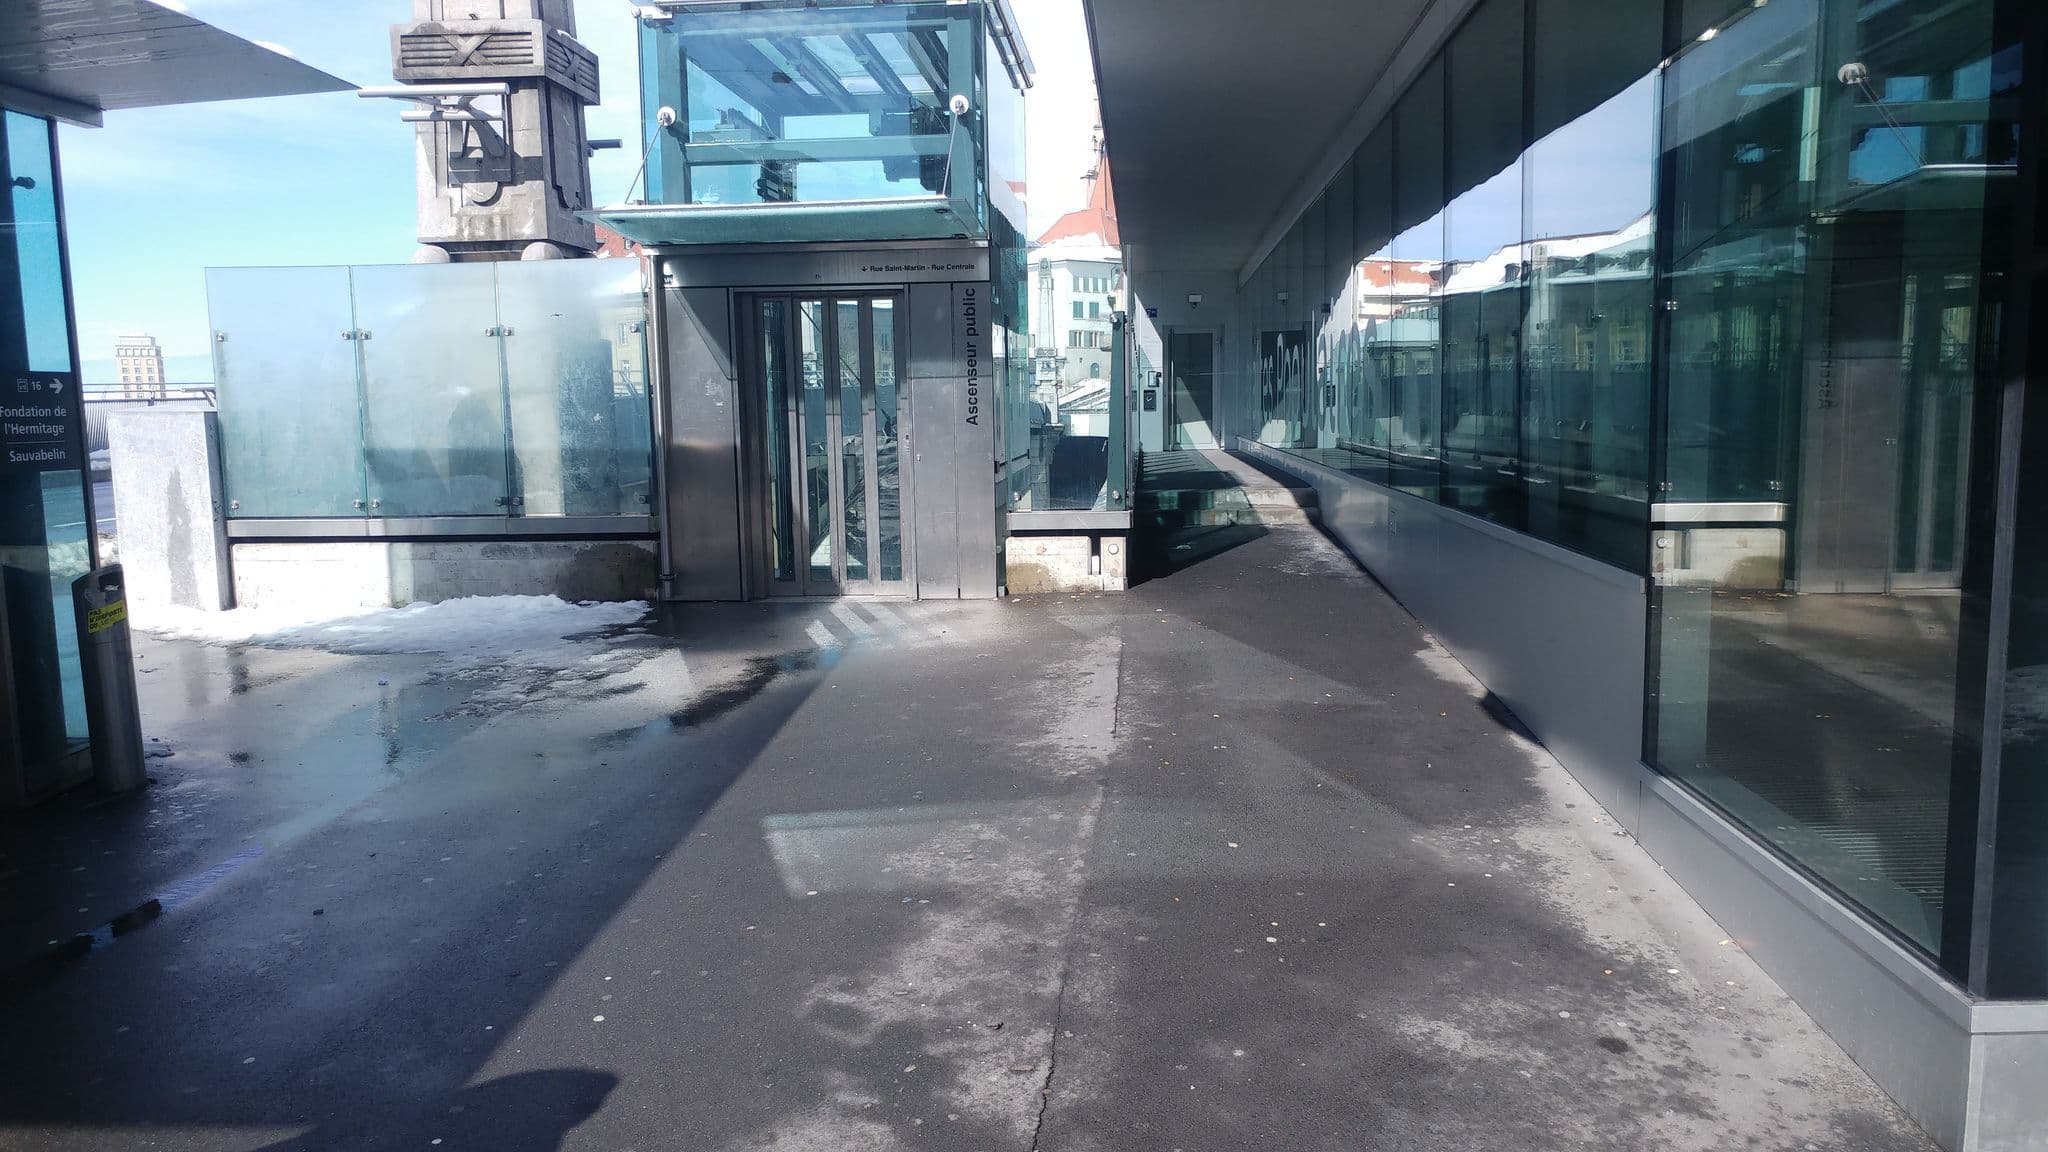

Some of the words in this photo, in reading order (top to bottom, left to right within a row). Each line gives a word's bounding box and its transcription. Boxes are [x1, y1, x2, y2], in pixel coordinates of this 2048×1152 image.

[885, 263, 926, 272] Saint-Martin
[932, 263, 945, 271] Rue
[946, 262, 975, 270] Centrale
[962, 287, 979, 337] public
[31, 381, 42, 391] 16
[965, 341, 978, 426] Ascenseur
[0, 406, 51, 417] Fondation
[54, 406, 67, 417] de
[4, 423, 65, 436] l'Hermitage
[9, 448, 66, 462] Sauvabelin
